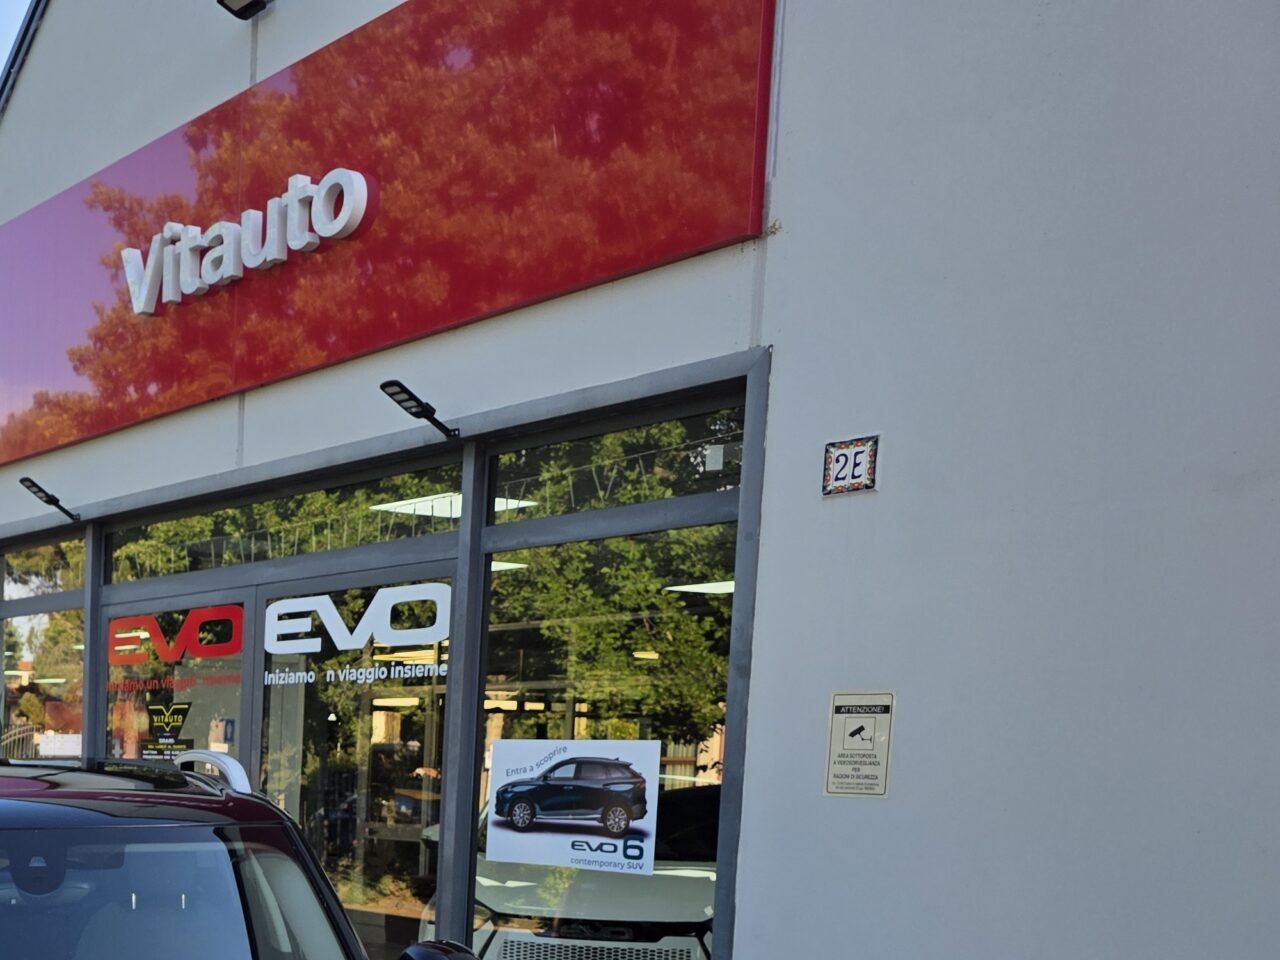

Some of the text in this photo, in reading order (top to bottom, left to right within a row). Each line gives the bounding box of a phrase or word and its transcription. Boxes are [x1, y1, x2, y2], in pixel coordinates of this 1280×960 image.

[121, 168, 368, 314] Vitauto
[834, 450, 866, 482] 2E
[264, 583, 452, 654] EVO
[109, 604, 243, 666] EVO
[264, 666, 316, 685] Iniziamo
[338, 664, 387, 684] viaggio
[390, 661, 448, 679] insieme
[505, 766, 528, 777] Entra
[535, 746, 568, 769] scoprire
[571, 835, 644, 860] EVO 6
[570, 857, 645, 870] contemporary SUV
